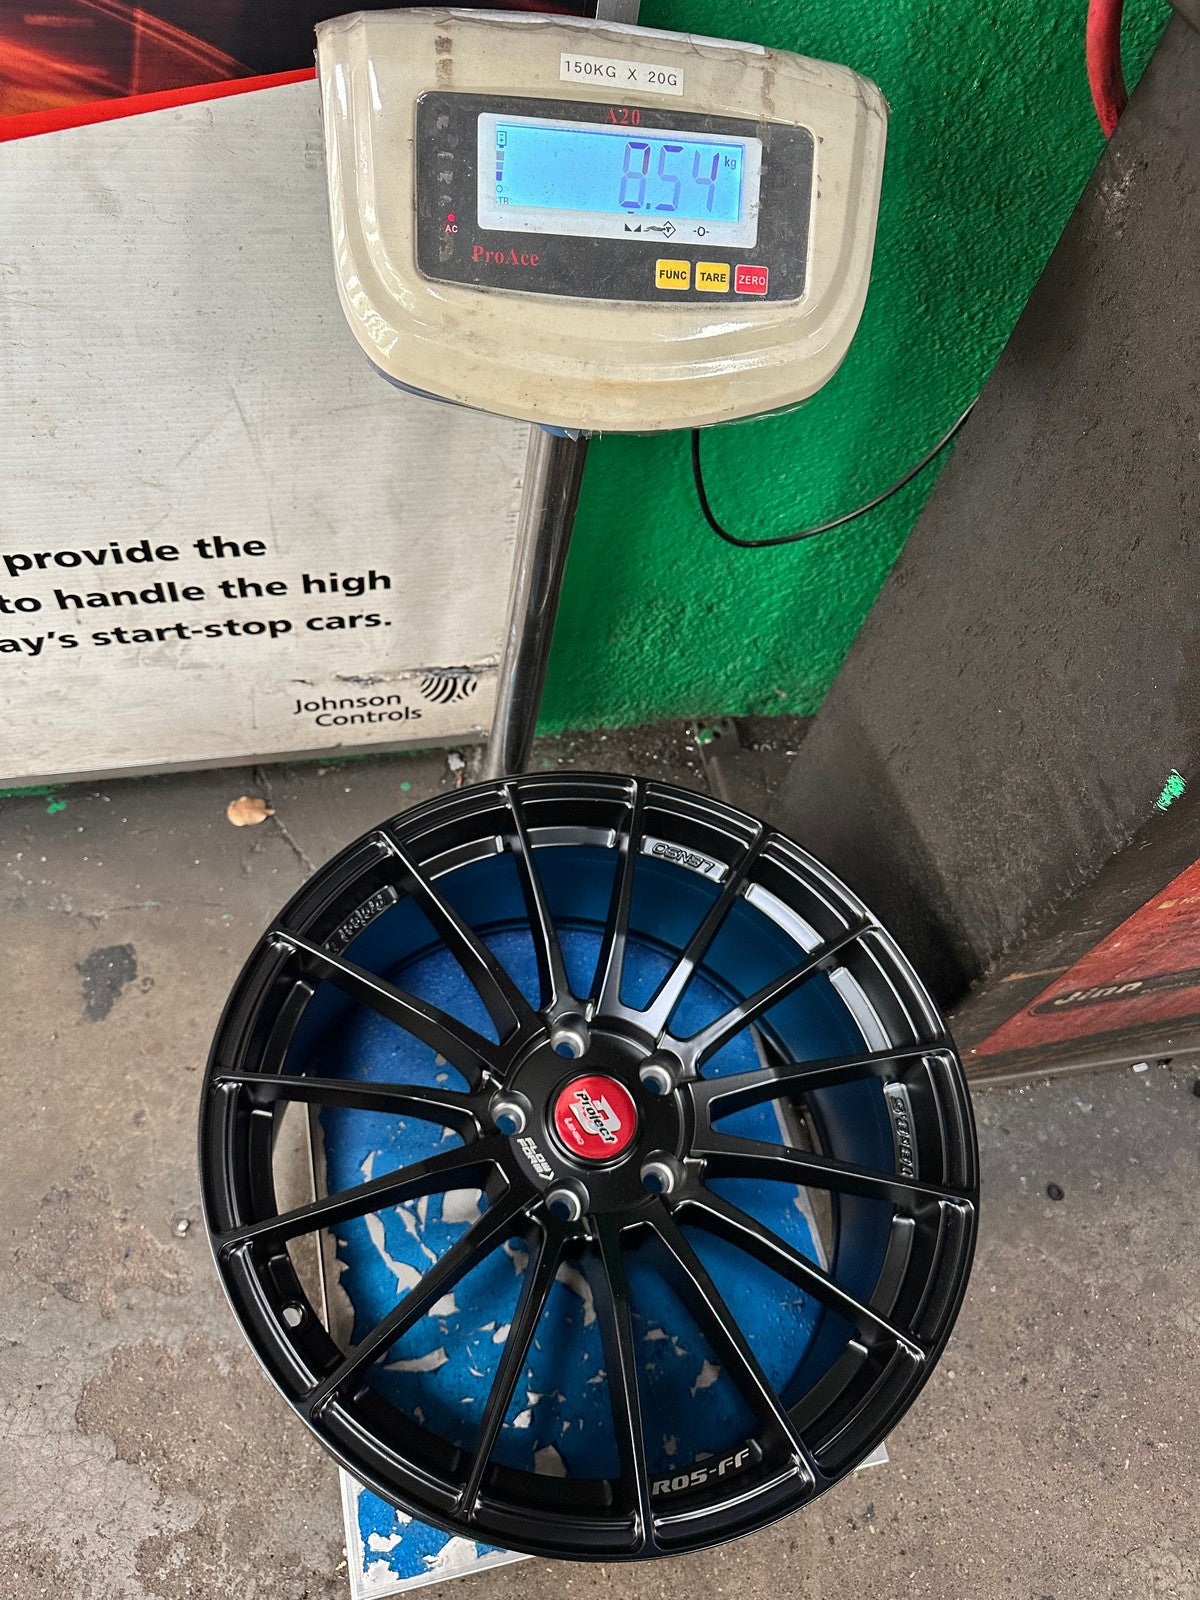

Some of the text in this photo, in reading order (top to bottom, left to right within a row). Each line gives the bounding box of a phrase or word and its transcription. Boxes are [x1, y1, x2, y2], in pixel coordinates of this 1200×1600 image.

[564, 60, 678, 87] 150KG X 20G
[604, 106, 641, 126] A20
[619, 142, 737, 212] 8.54 kg
[445, 225, 458, 233] AC
[471, 245, 540, 267] ProAce
[659, 269, 687, 282] FUNC
[700, 271, 727, 284] TARE
[738, 274, 766, 287] ZERO
[2, 535, 267, 577] provide the
[53, 582, 205, 610] handle
[218, 577, 288, 599] the
[301, 570, 392, 597] high
[91, 616, 293, 646] start-stop
[305, 611, 392, 631] cars.
[293, 694, 402, 715] Johnson
[315, 707, 422, 727] Controls
[651, 842, 716, 873] LENSO
[573, 1088, 618, 1144] Project
